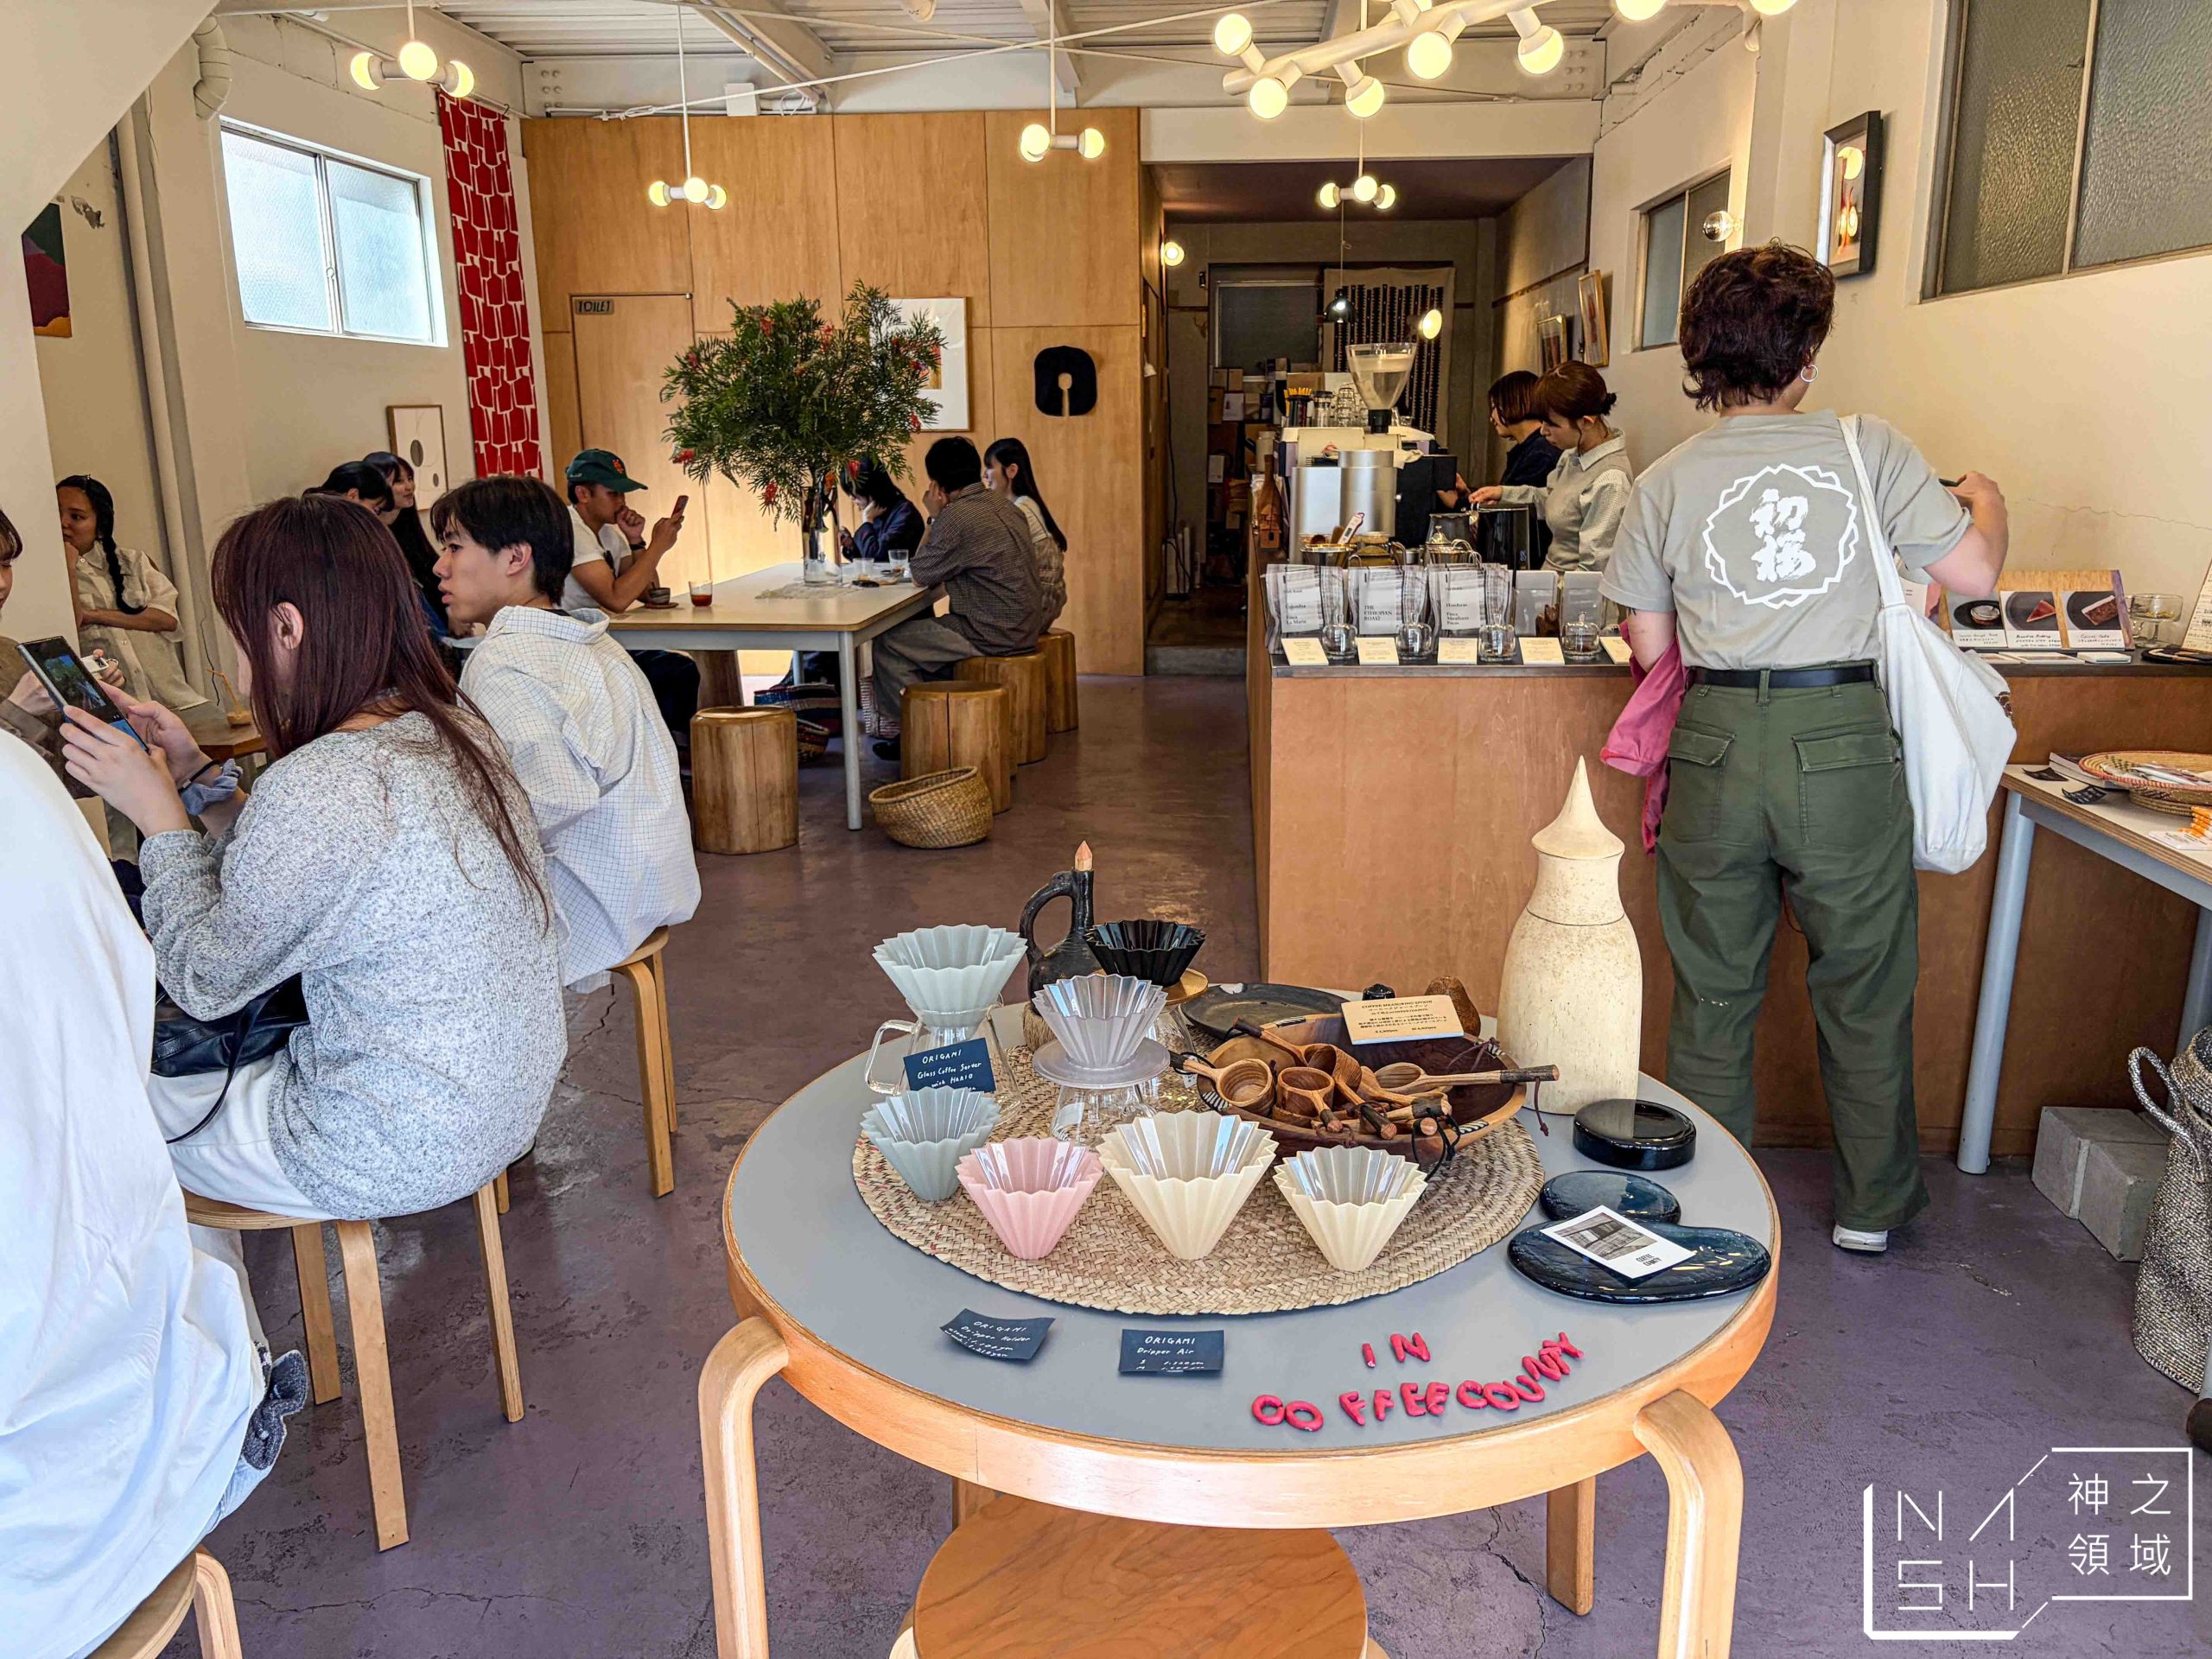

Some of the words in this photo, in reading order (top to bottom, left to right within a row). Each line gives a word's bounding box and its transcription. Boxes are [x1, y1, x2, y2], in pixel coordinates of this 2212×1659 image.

[578, 300, 610, 313] TOILET
[922, 1049, 962, 1065] ORIGAMI
[917, 1071, 937, 1080] Glass
[938, 1066, 957, 1076] Coffee
[959, 1062, 982, 1072] Server
[973, 1320, 1027, 1332] ORIGAMI
[1145, 1336, 1196, 1345] ORIGAMI
[1136, 1347, 1172, 1356] Dripper
[1362, 1332, 1432, 1368] IN
